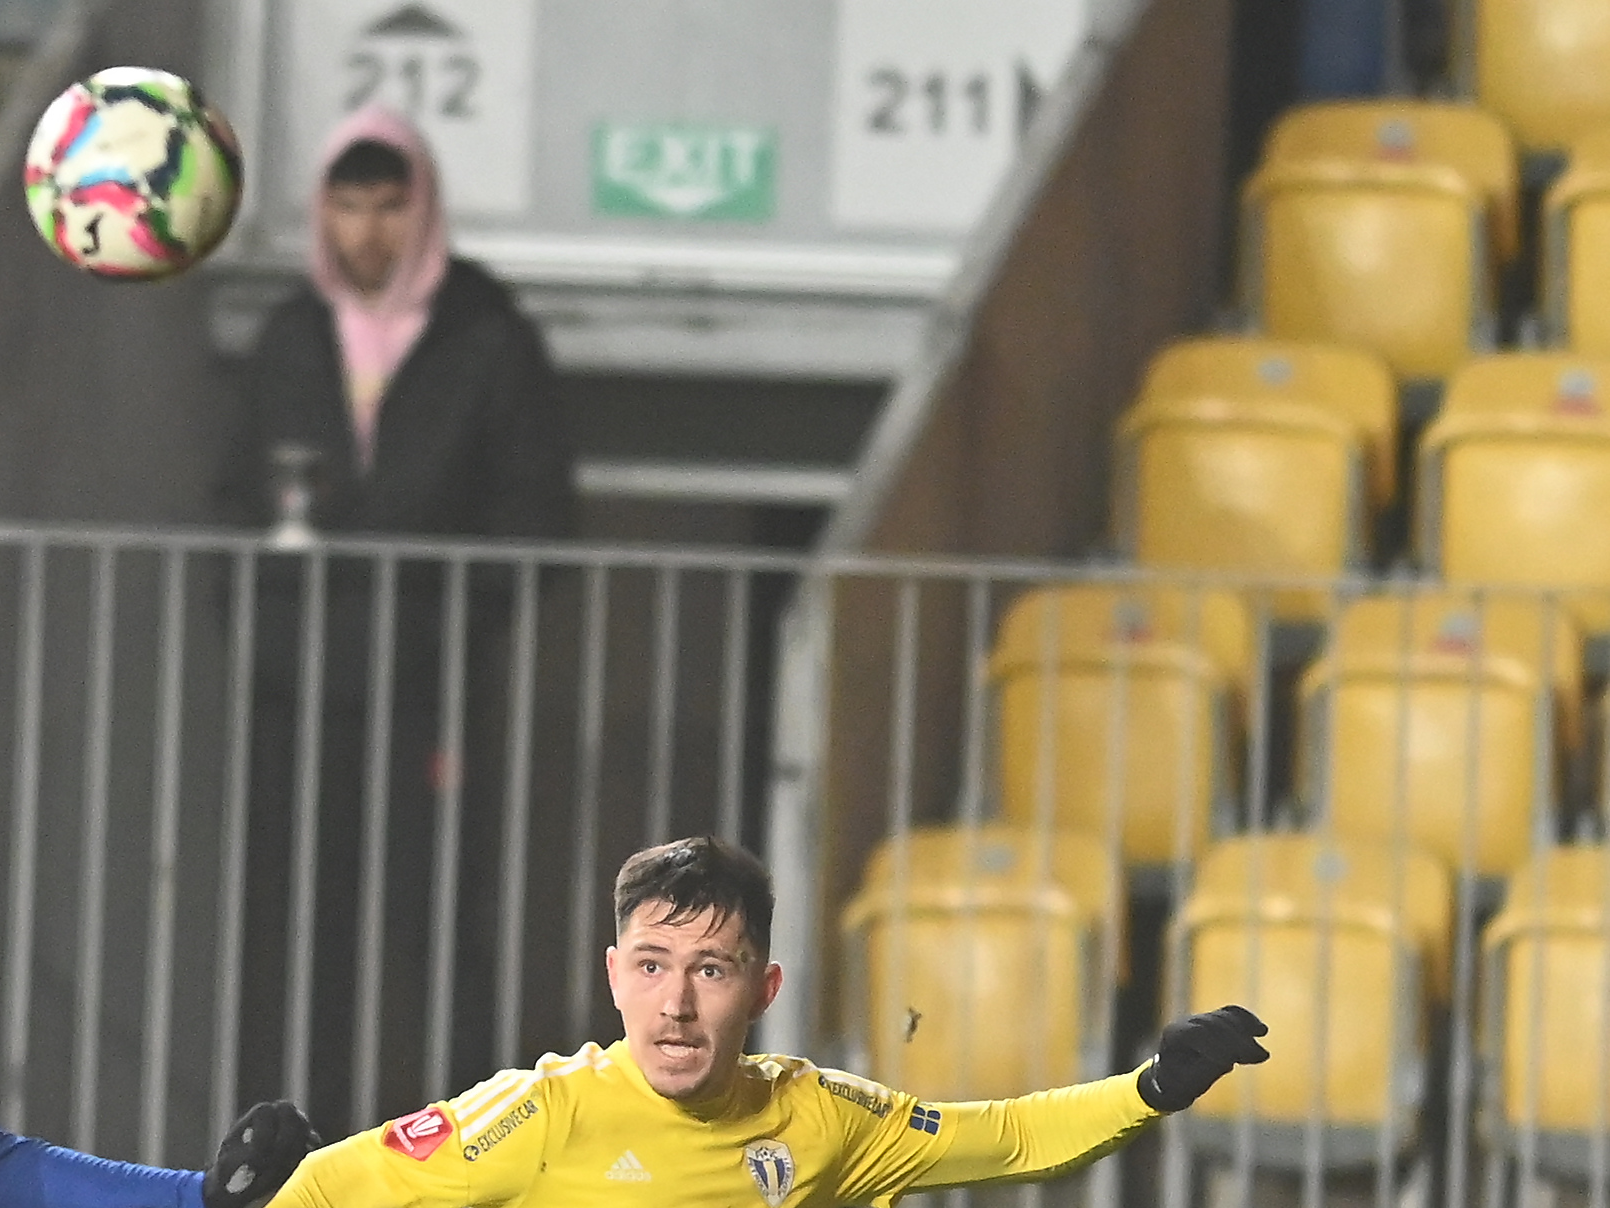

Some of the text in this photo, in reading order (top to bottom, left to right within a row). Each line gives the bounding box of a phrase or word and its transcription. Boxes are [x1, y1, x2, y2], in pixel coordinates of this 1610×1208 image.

[346, 52, 480, 119] 212
[865, 66, 990, 134] 211
[602, 130, 763, 182] EXIT
[477, 1099, 539, 1153] EXCLUSIVE CAR
